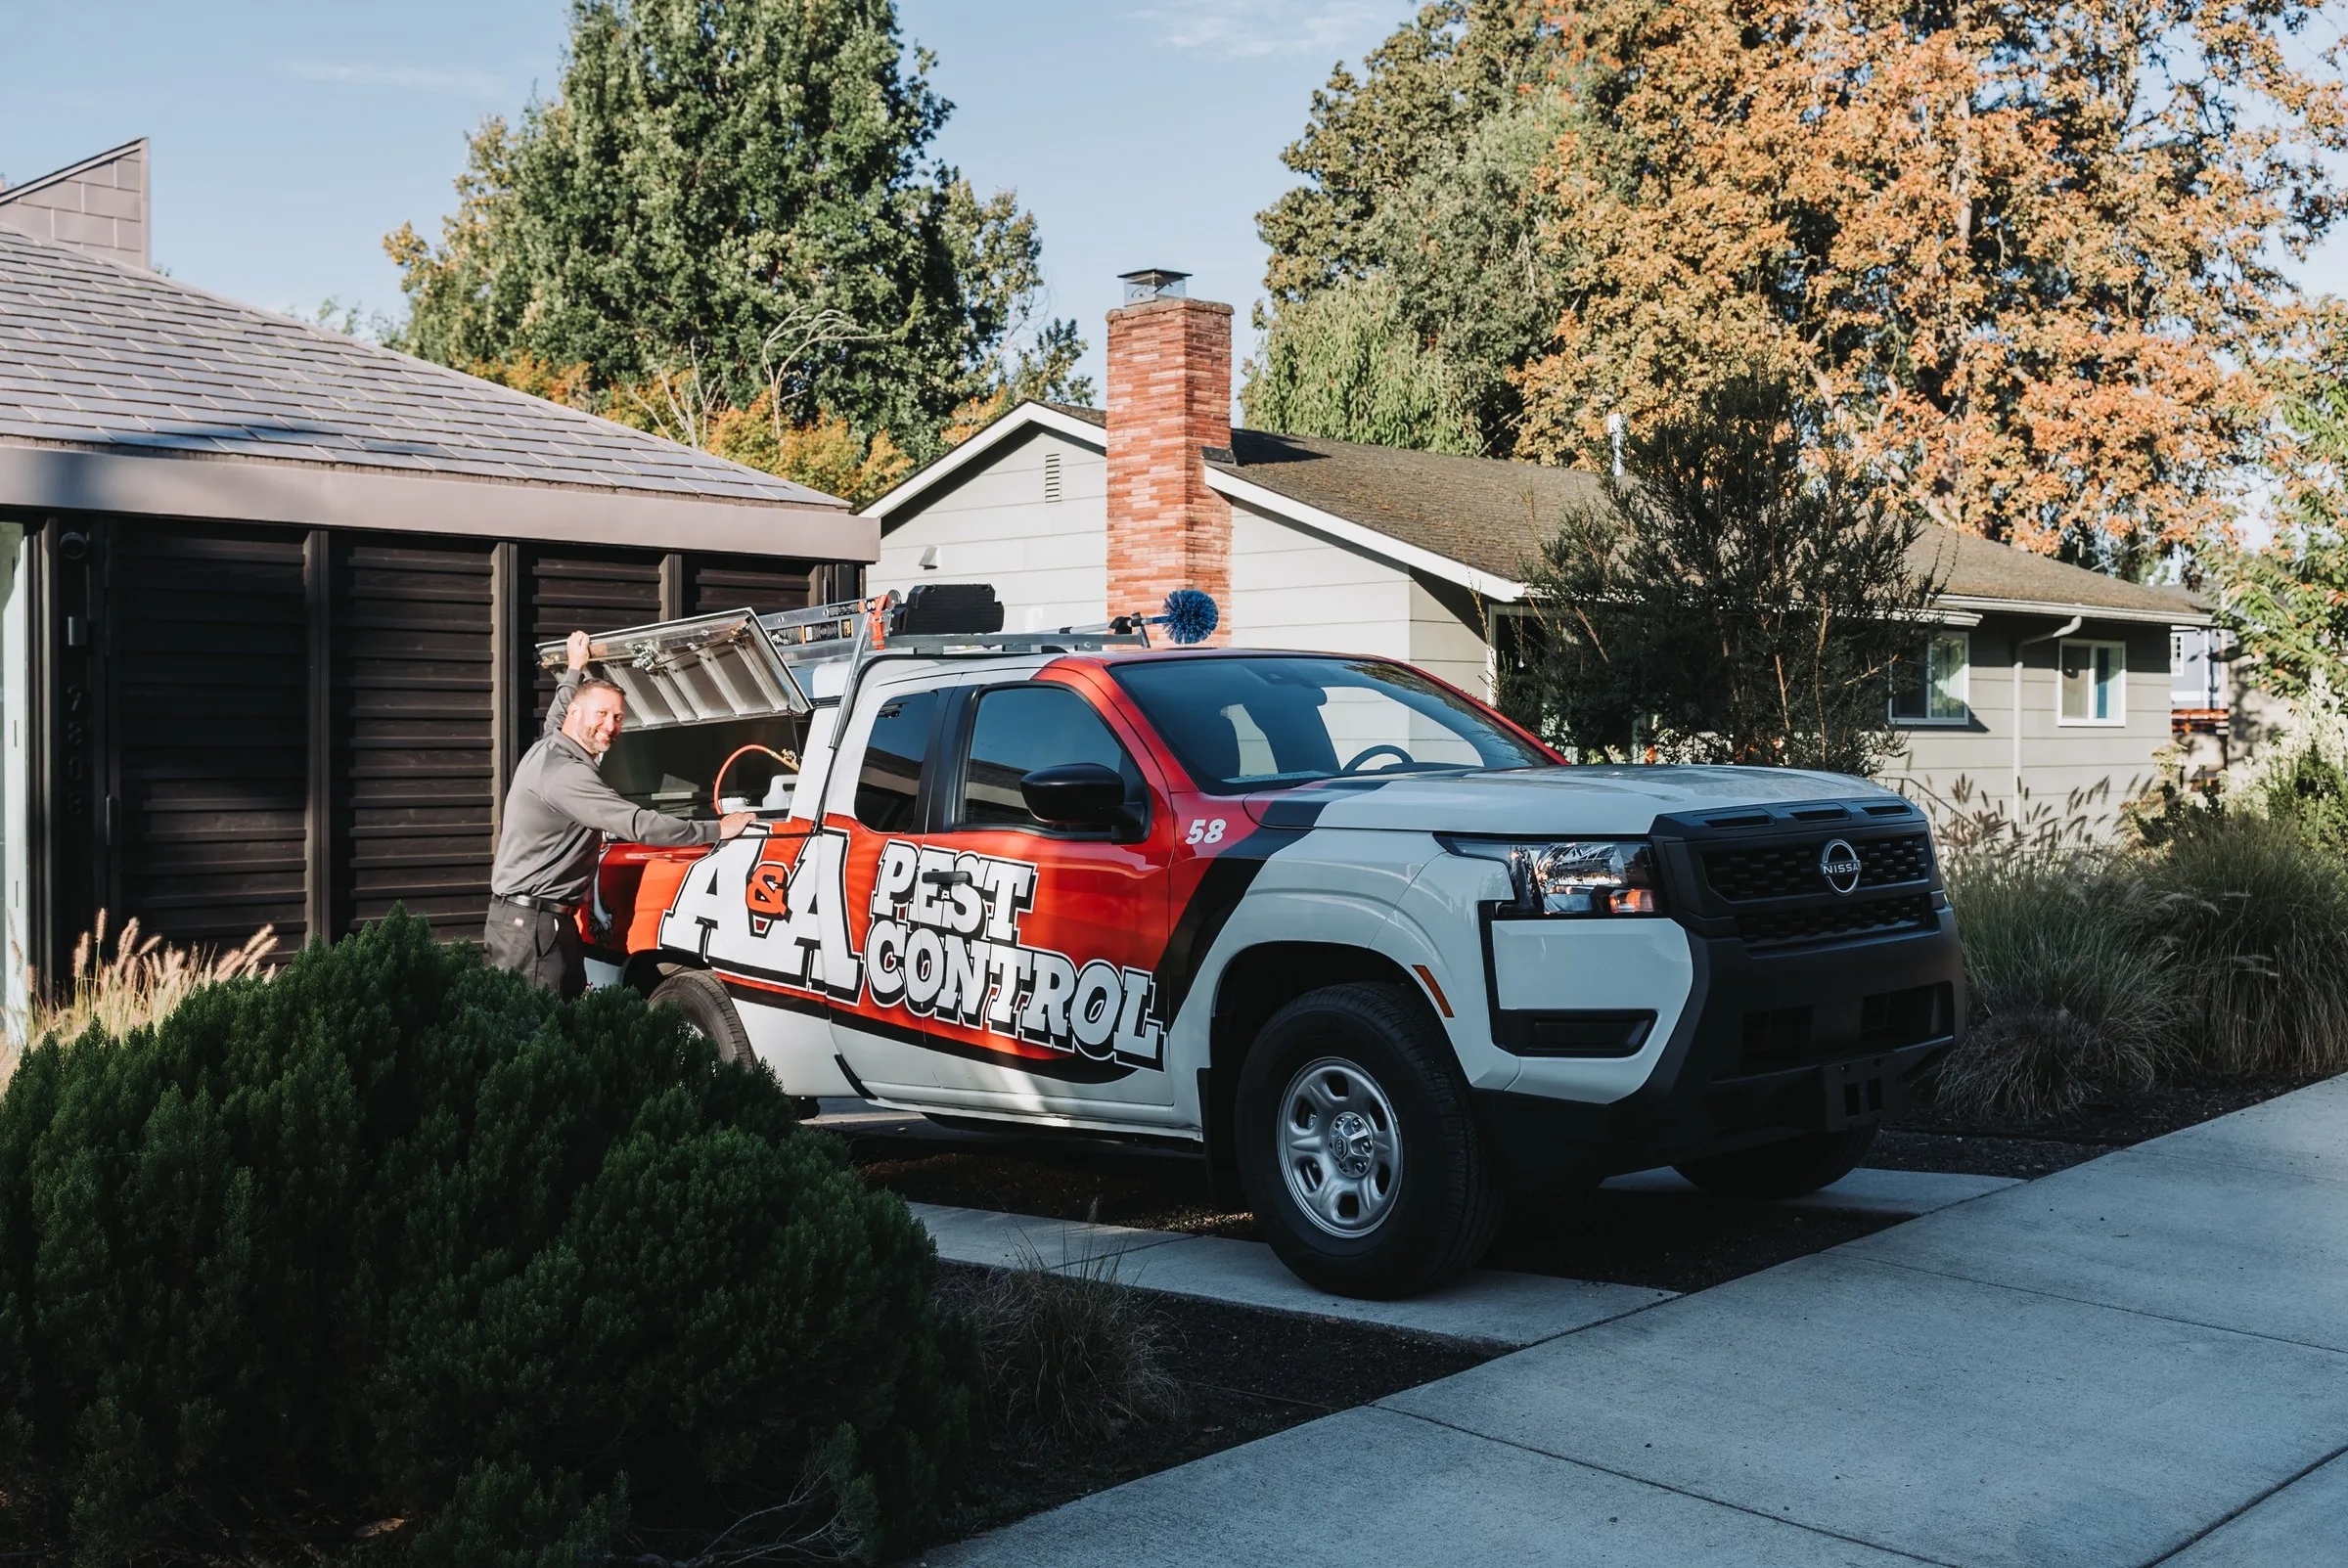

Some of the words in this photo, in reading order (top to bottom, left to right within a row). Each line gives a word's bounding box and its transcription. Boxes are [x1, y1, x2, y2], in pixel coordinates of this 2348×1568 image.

[1185, 818, 1227, 845] 58
[1823, 863, 1861, 874] NISSA
[658, 824, 863, 1005] A&A
[871, 840, 1037, 941] PEST
[866, 919, 1167, 1072] CONTROL
